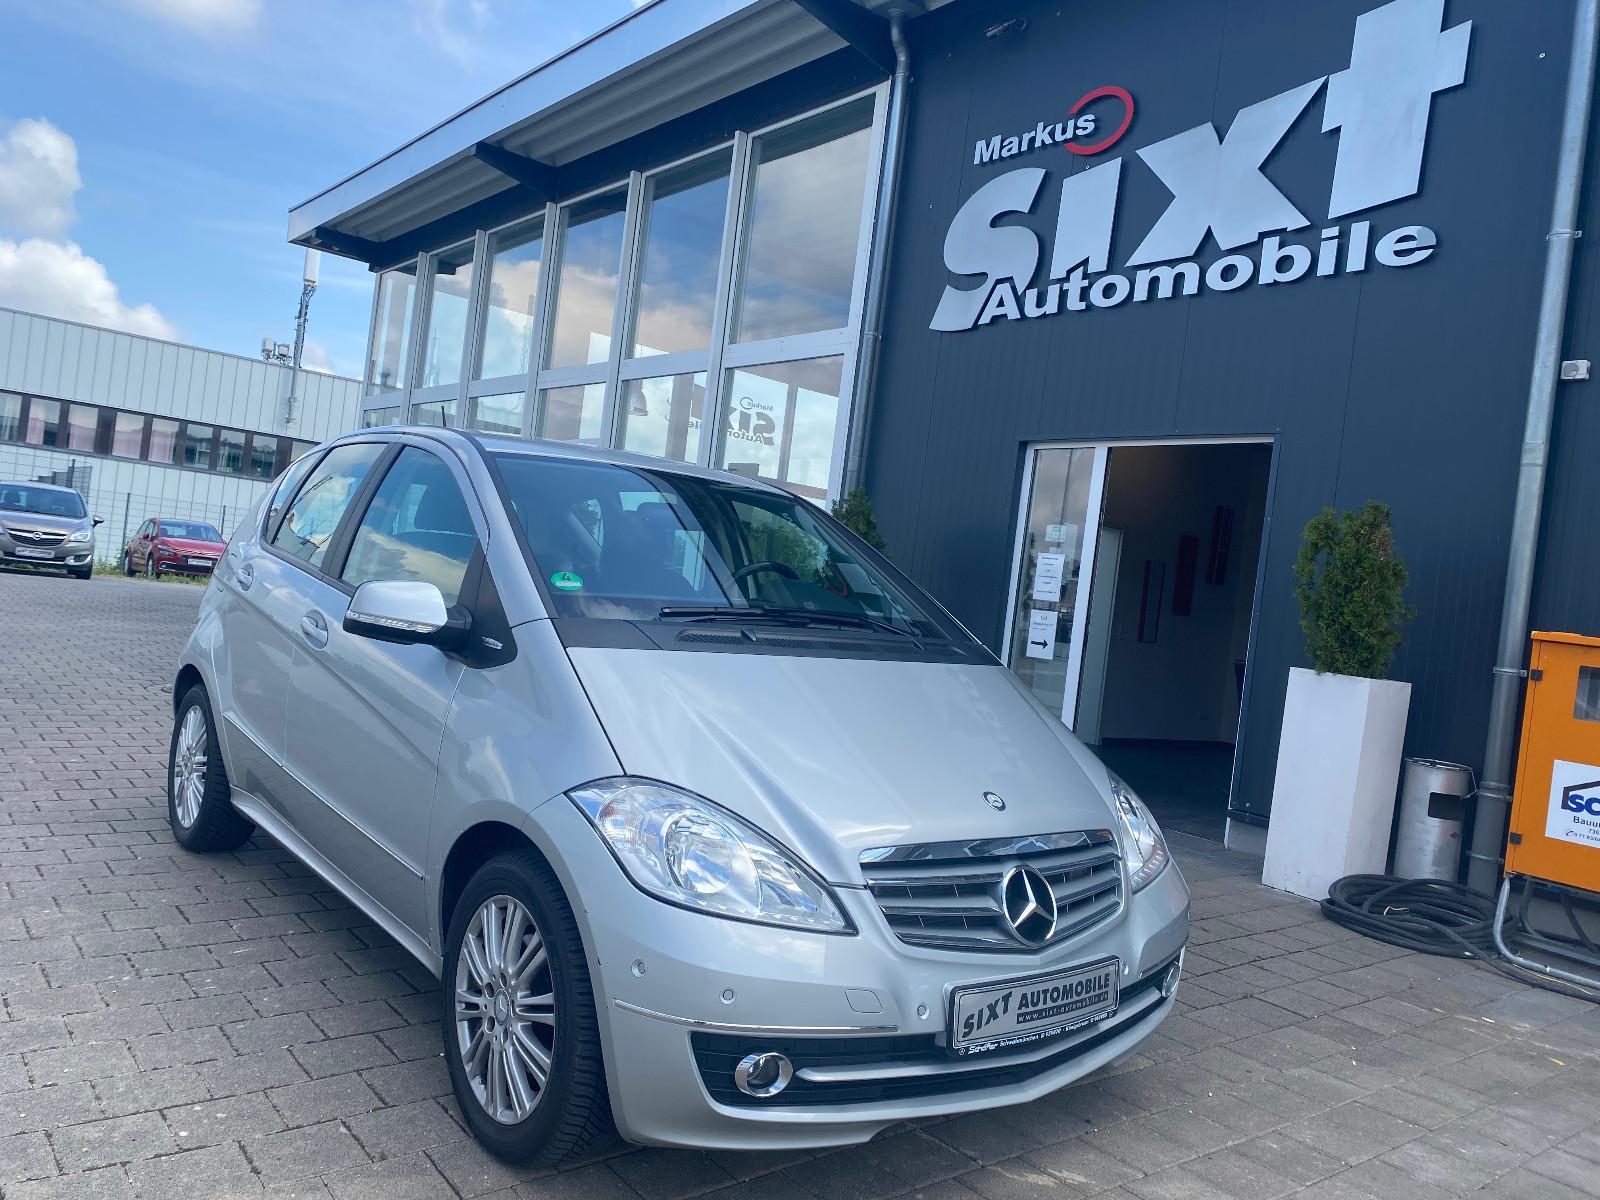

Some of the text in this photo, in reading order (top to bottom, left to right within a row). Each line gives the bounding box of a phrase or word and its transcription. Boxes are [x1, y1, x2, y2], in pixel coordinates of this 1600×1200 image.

[973, 109, 1096, 166] Markus
[977, 220, 1438, 326] Automobile
[1573, 815, 1600, 829] Bauu
[961, 972, 1111, 1039] SIXT AUTOMOBILE
